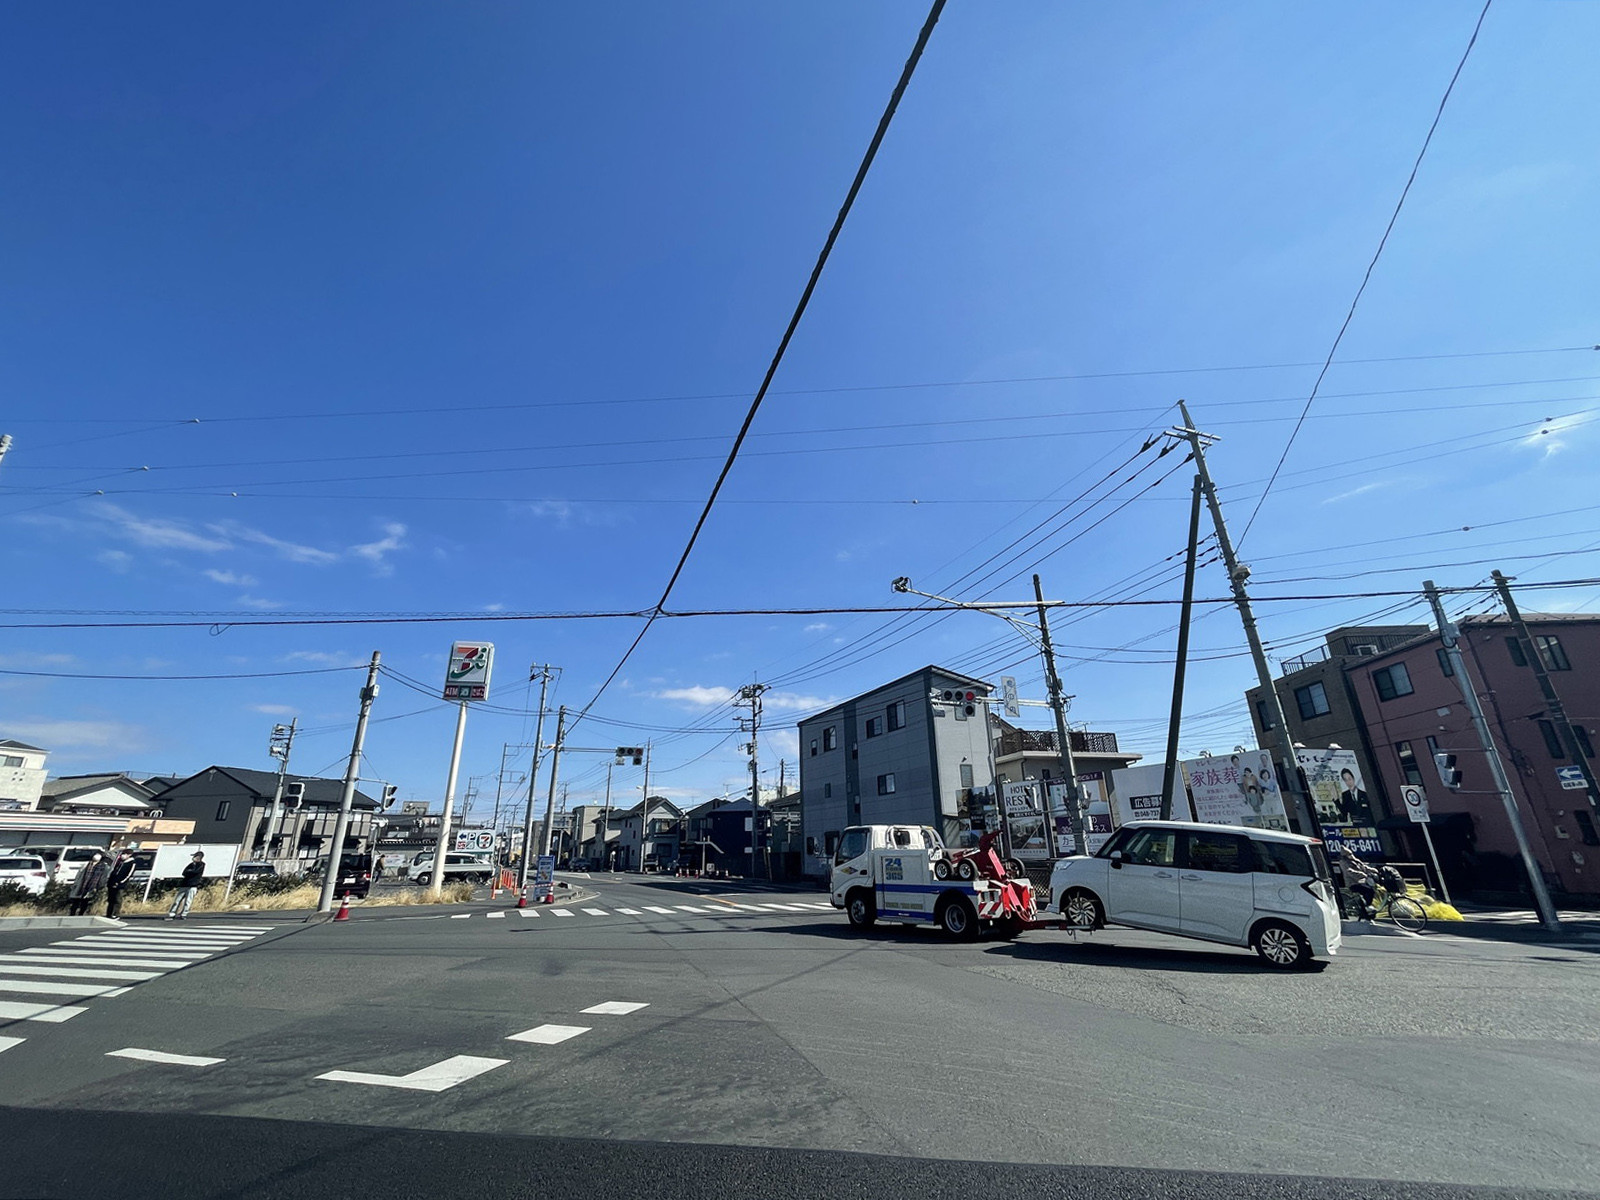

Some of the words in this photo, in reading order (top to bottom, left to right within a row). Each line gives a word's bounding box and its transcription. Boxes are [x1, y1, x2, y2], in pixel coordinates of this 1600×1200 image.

[1190, 767, 1240, 788] 家族葬
[1325, 839, 1382, 853] 120-25-6411
[885, 858, 902, 867] 24
[886, 872, 904, 880] 365
